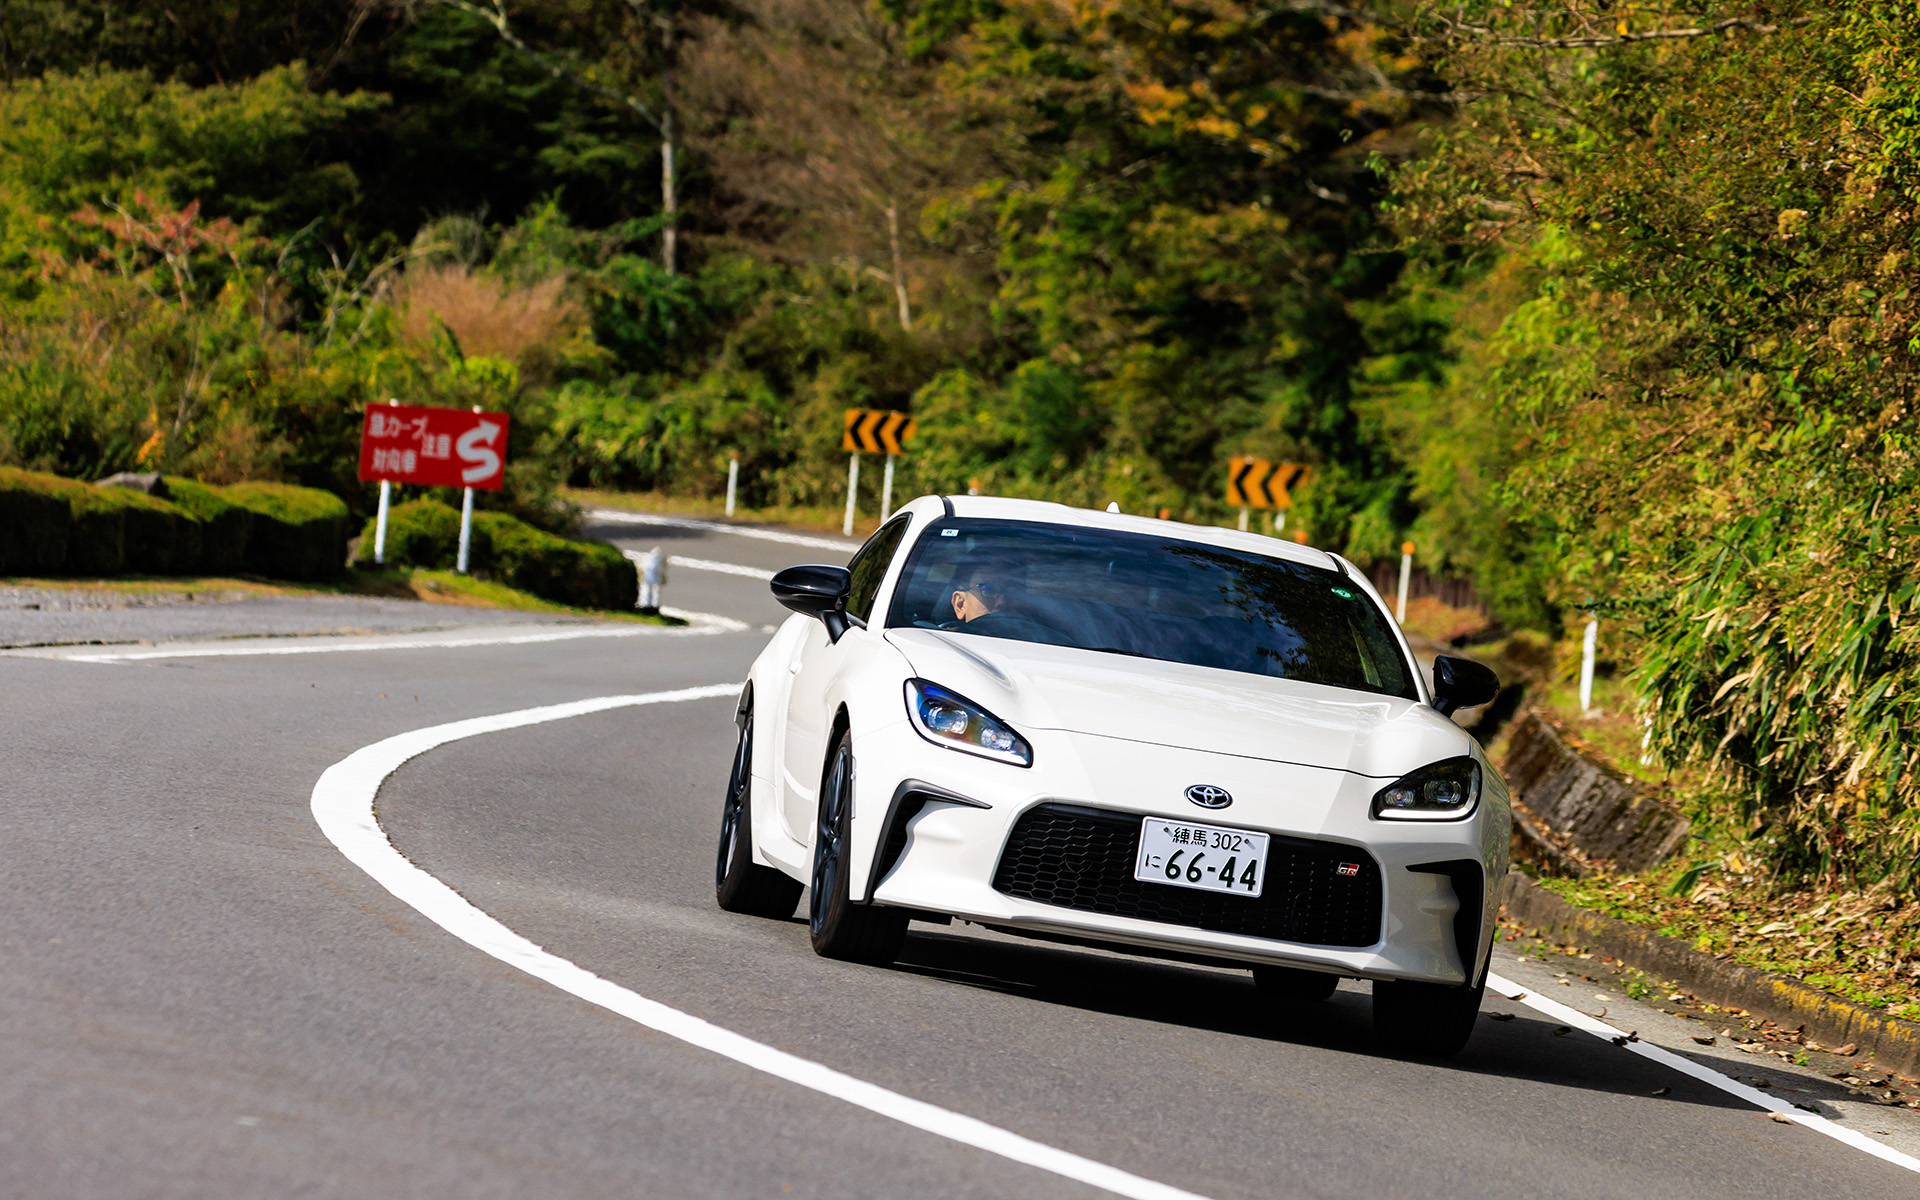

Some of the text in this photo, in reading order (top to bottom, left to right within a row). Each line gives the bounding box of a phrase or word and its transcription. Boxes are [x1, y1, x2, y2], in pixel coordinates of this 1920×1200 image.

[1172, 826, 1242, 852] 練馬 302
[1144, 848, 1257, 891] に 66-44
